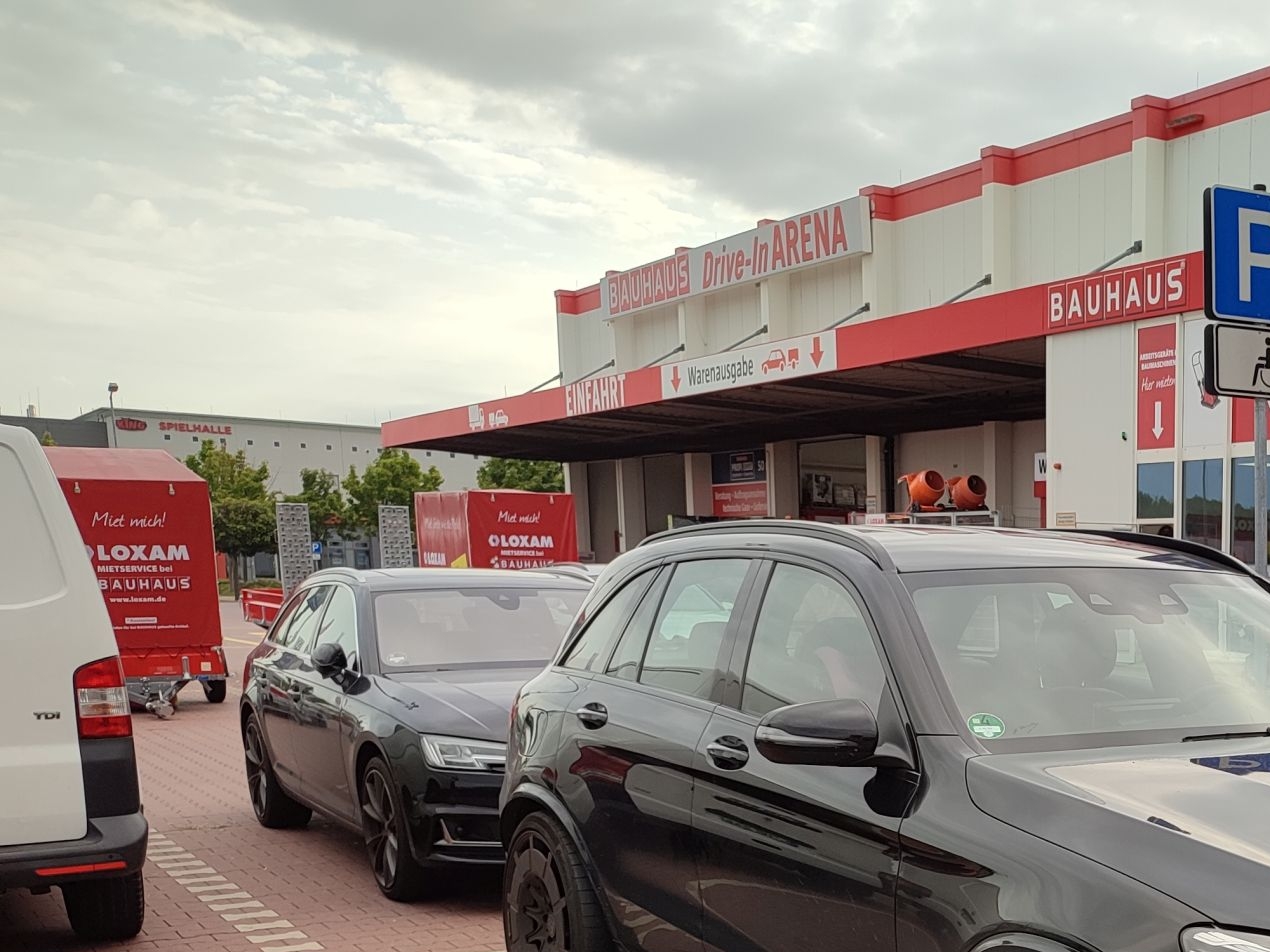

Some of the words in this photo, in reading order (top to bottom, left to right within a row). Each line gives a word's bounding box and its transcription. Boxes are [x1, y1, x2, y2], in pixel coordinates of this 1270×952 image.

[608, 255, 689, 309] BAUHAUS
[702, 237, 768, 290] Drive-In
[772, 205, 848, 271] ARENA
[1050, 264, 1185, 323] BAUHAUS
[687, 355, 754, 387] Warenausgabe
[1141, 377, 1155, 392] Hier
[565, 374, 626, 417] EINFAHRT
[159, 422, 232, 435] SPIELHALLE
[92, 511, 125, 528] Miet
[130, 511, 166, 528] mich!
[498, 510, 517, 523] Miet
[519, 511, 541, 524] mich!
[501, 535, 554, 548] LOXAM
[97, 544, 190, 561] LOXAM
[97, 565, 158, 573] MIETSERVICE
[159, 565, 173, 573] bei
[98, 577, 191, 591] BAUHAUS
[109, 595, 167, 603] www.loxam.de
[33, 711, 61, 720] TDI
